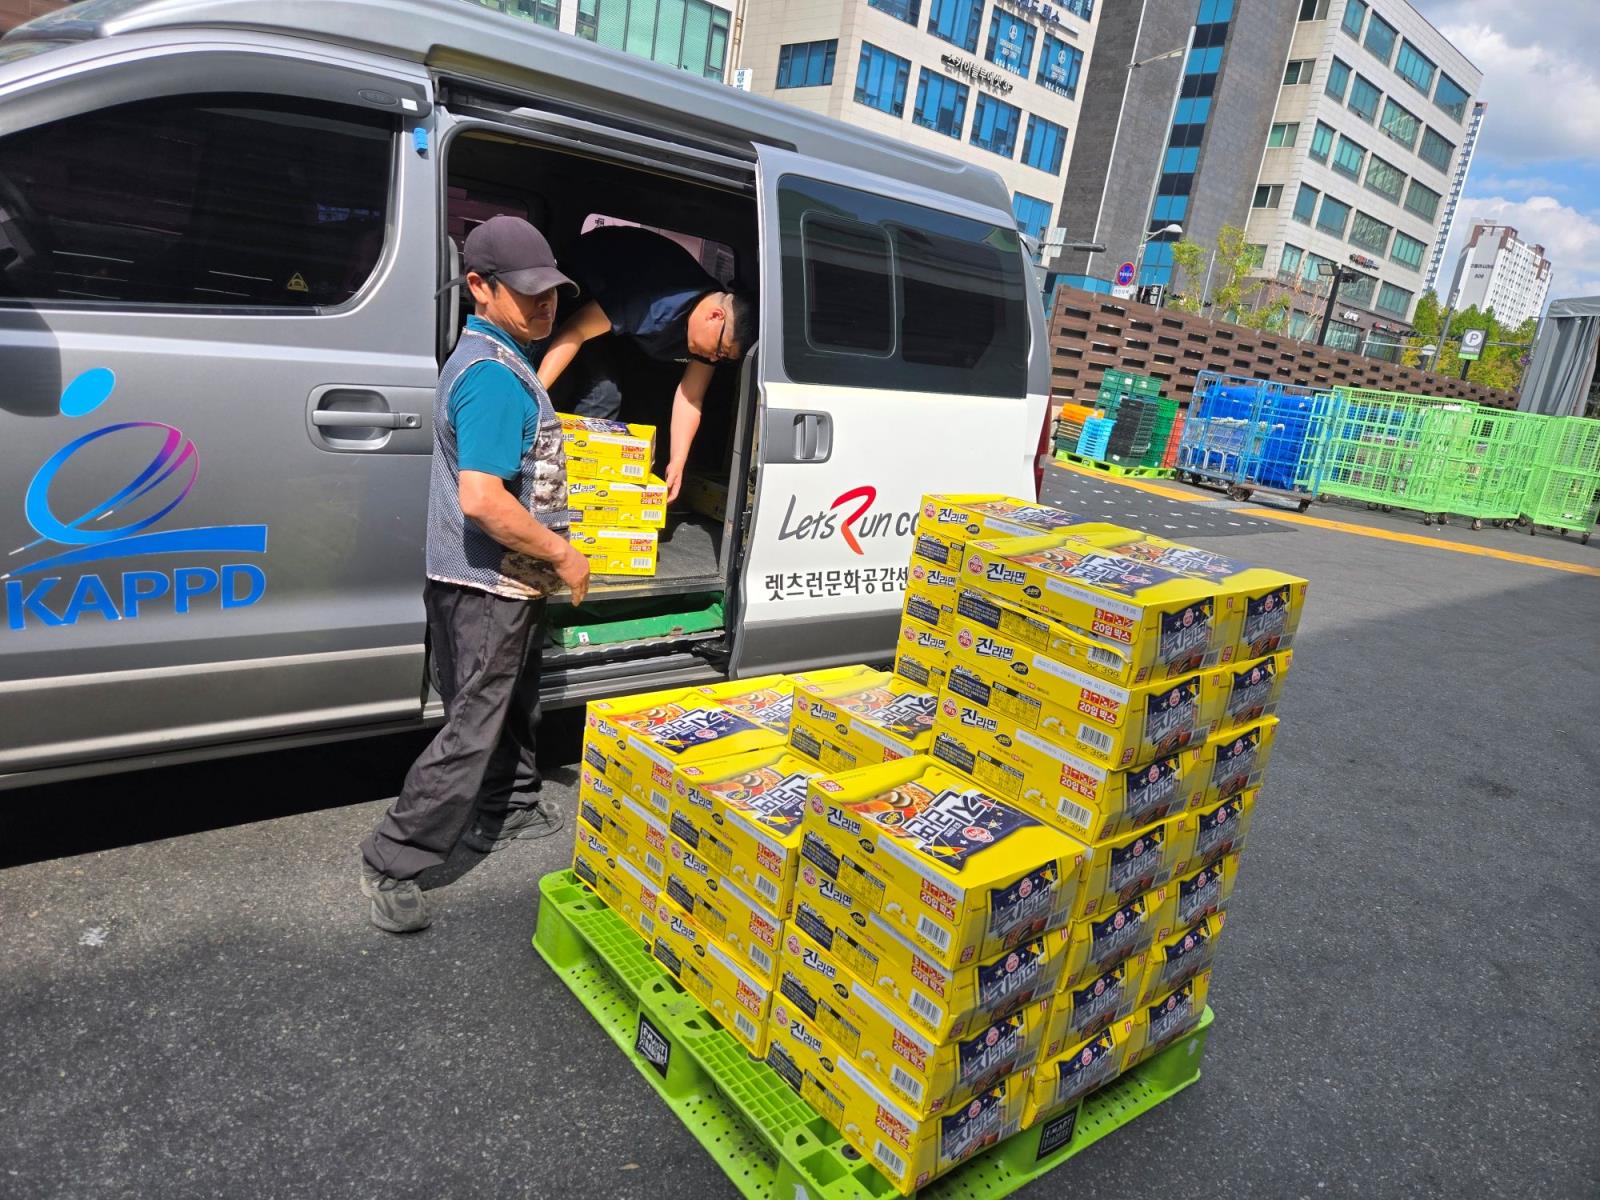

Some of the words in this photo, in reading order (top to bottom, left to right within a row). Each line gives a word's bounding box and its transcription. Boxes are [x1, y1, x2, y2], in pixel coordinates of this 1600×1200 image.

[938, 508, 968, 524] 진라면
[927, 570, 956, 586] 진라면
[987, 563, 1027, 585] 진라면
[5, 564, 266, 631] KAPPD
[918, 632, 946, 649] 진라면
[1093, 621, 1113, 636] 20입
[1112, 627, 1131, 641] 박스
[976, 637, 1015, 661] 진라면
[810, 703, 837, 722] 진라면
[960, 707, 998, 733] 진라면
[1079, 701, 1098, 717] 20입
[1099, 708, 1117, 723] 박스
[688, 788, 713, 810] 진라면
[1061, 777, 1079, 791] 20입
[1081, 783, 1095, 798] 박스
[826, 806, 862, 835] 진라면
[903, 790, 987, 849] 진라면
[684, 852, 709, 875] 진라면
[819, 878, 852, 907] 진라면
[921, 892, 939, 908] 20입
[940, 902, 955, 920] 박스
[671, 916, 696, 941] 진라면
[803, 948, 836, 979] 진라면
[912, 968, 929, 986] 20입
[930, 979, 944, 997] 박스
[790, 1020, 822, 1053] 진라면
[893, 1042, 910, 1060] 20입
[910, 1053, 925, 1072] 박스
[876, 1118, 893, 1136] 20입
[893, 1129, 909, 1149] 박스
